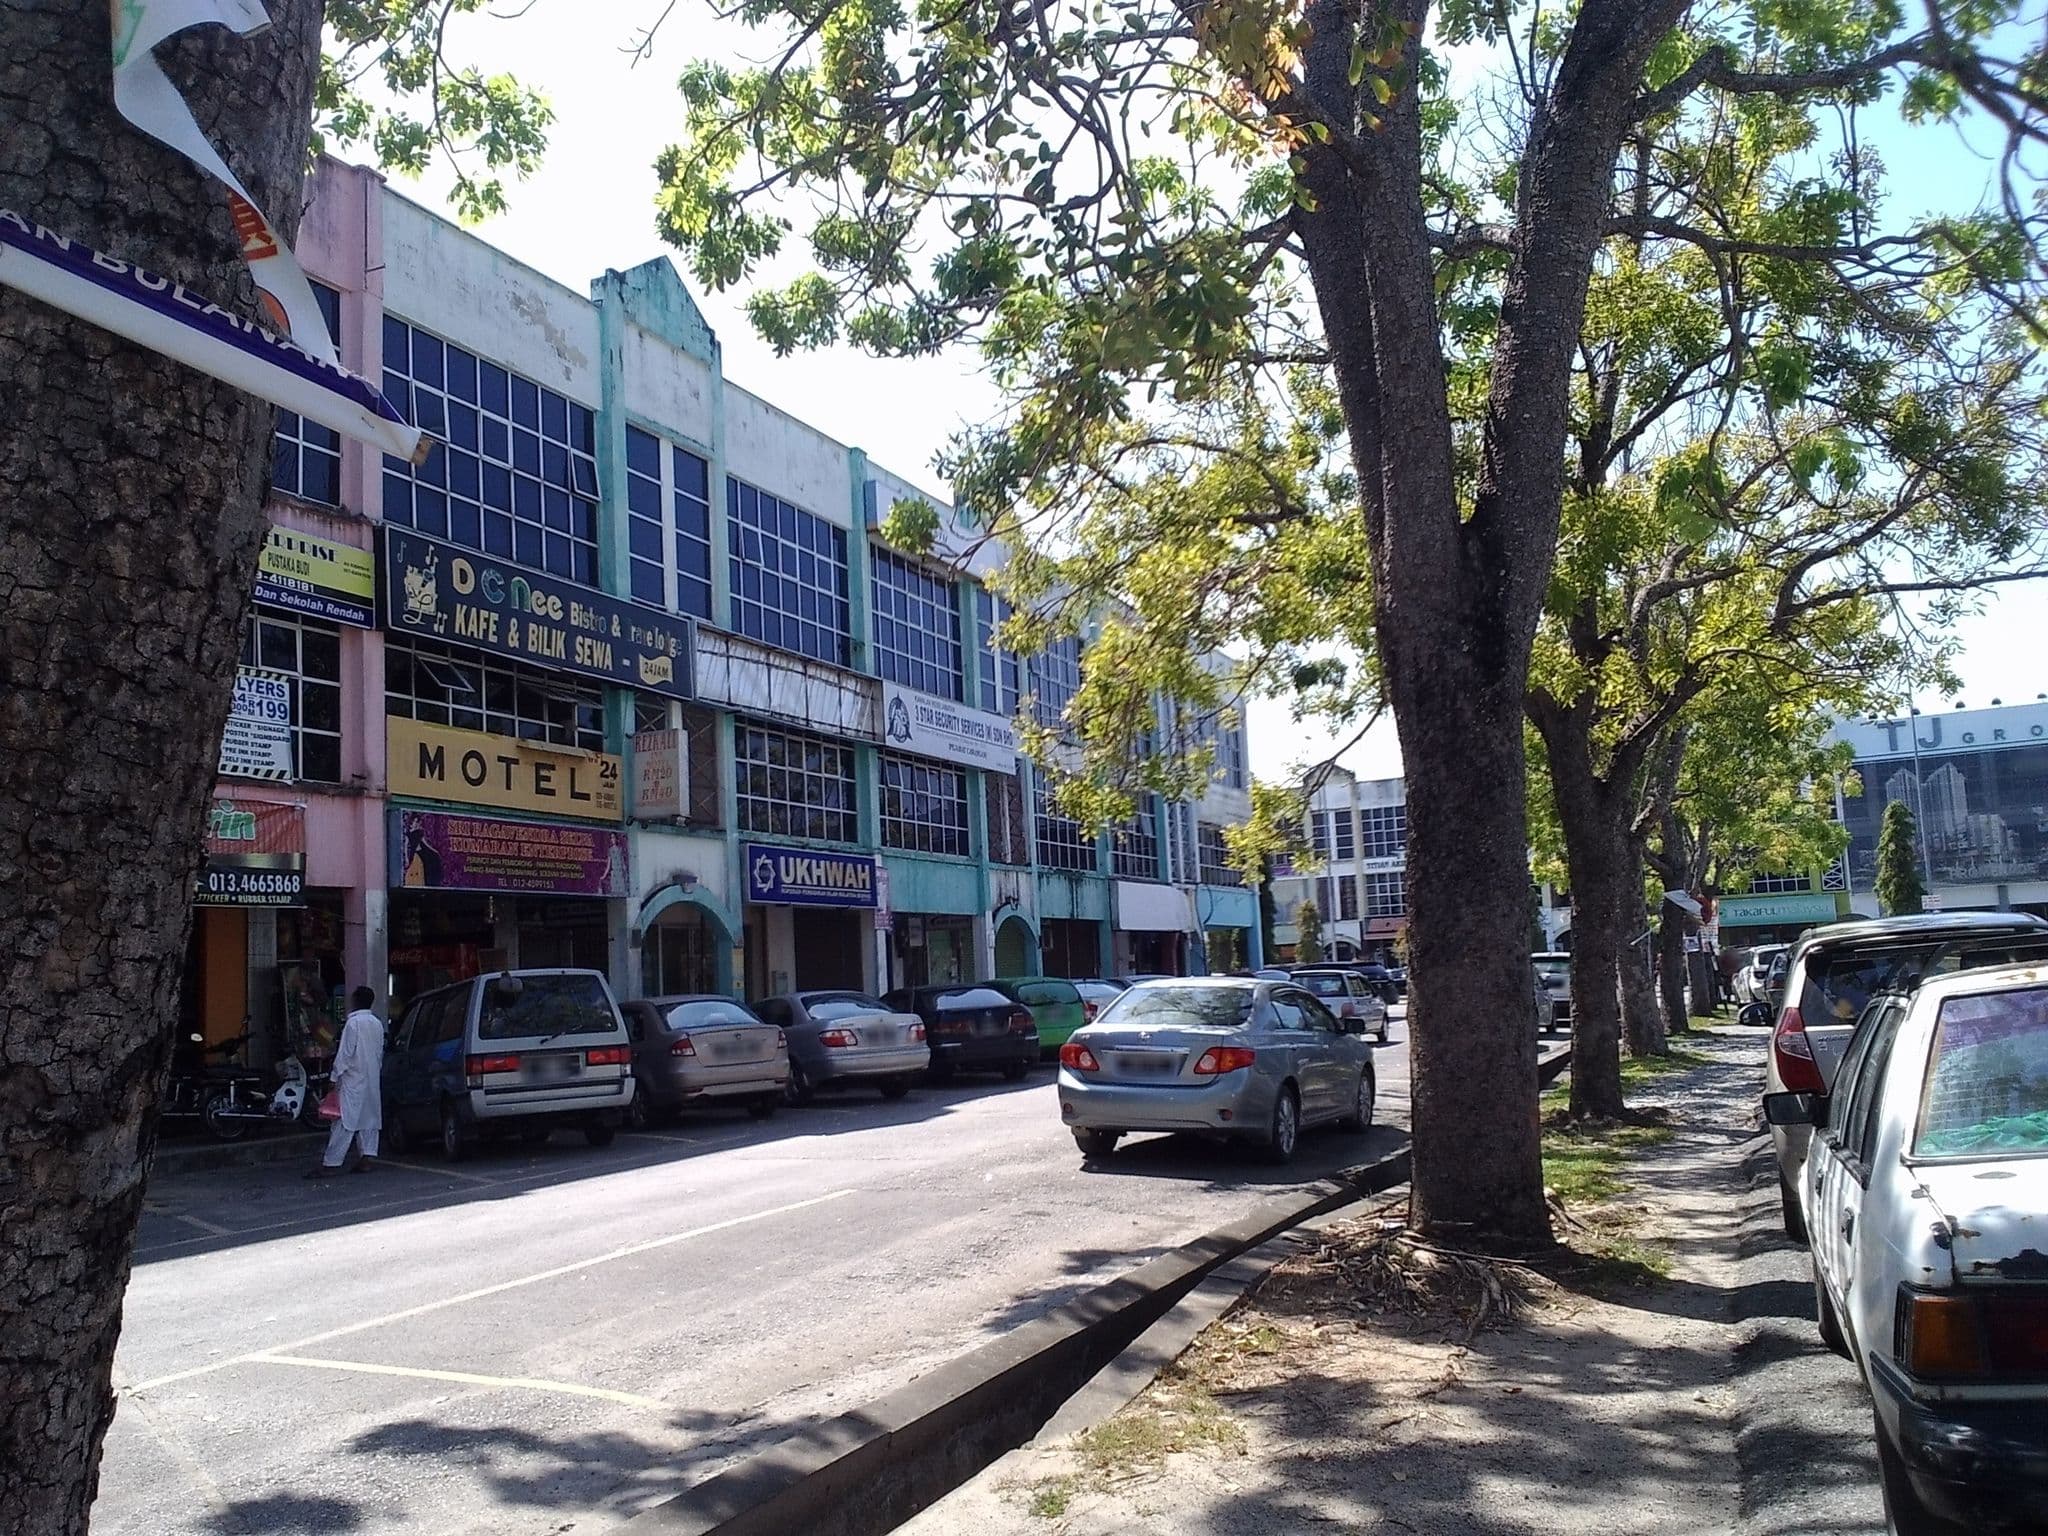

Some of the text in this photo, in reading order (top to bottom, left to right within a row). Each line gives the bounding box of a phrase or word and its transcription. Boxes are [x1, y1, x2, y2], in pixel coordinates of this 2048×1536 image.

[267, 552, 310, 577] PUSTAKA BUDI
[254, 586, 365, 621] Dan Sekolah Rendah
[455, 603, 499, 643] KAFE
[508, 617, 519, 648] &
[528, 622, 566, 660] BILIK
[575, 635, 613, 672] SEWA
[611, 614, 621, 637] &
[257, 699, 288, 720] 199
[920, 705, 934, 725] STAR
[935, 711, 960, 732] SECURITY
[961, 718, 985, 739] SERVICES
[250, 741, 272, 749] STAMP
[1877, 717, 1942, 752] TJ
[250, 750, 272, 758] STAMP
[252, 759, 275, 767] STAMP
[419, 743, 618, 801] MOTEL 24
[209, 873, 300, 893] 013.4665868
[780, 856, 871, 889] UKHWAH
[267, 895, 292, 904] STAMP
